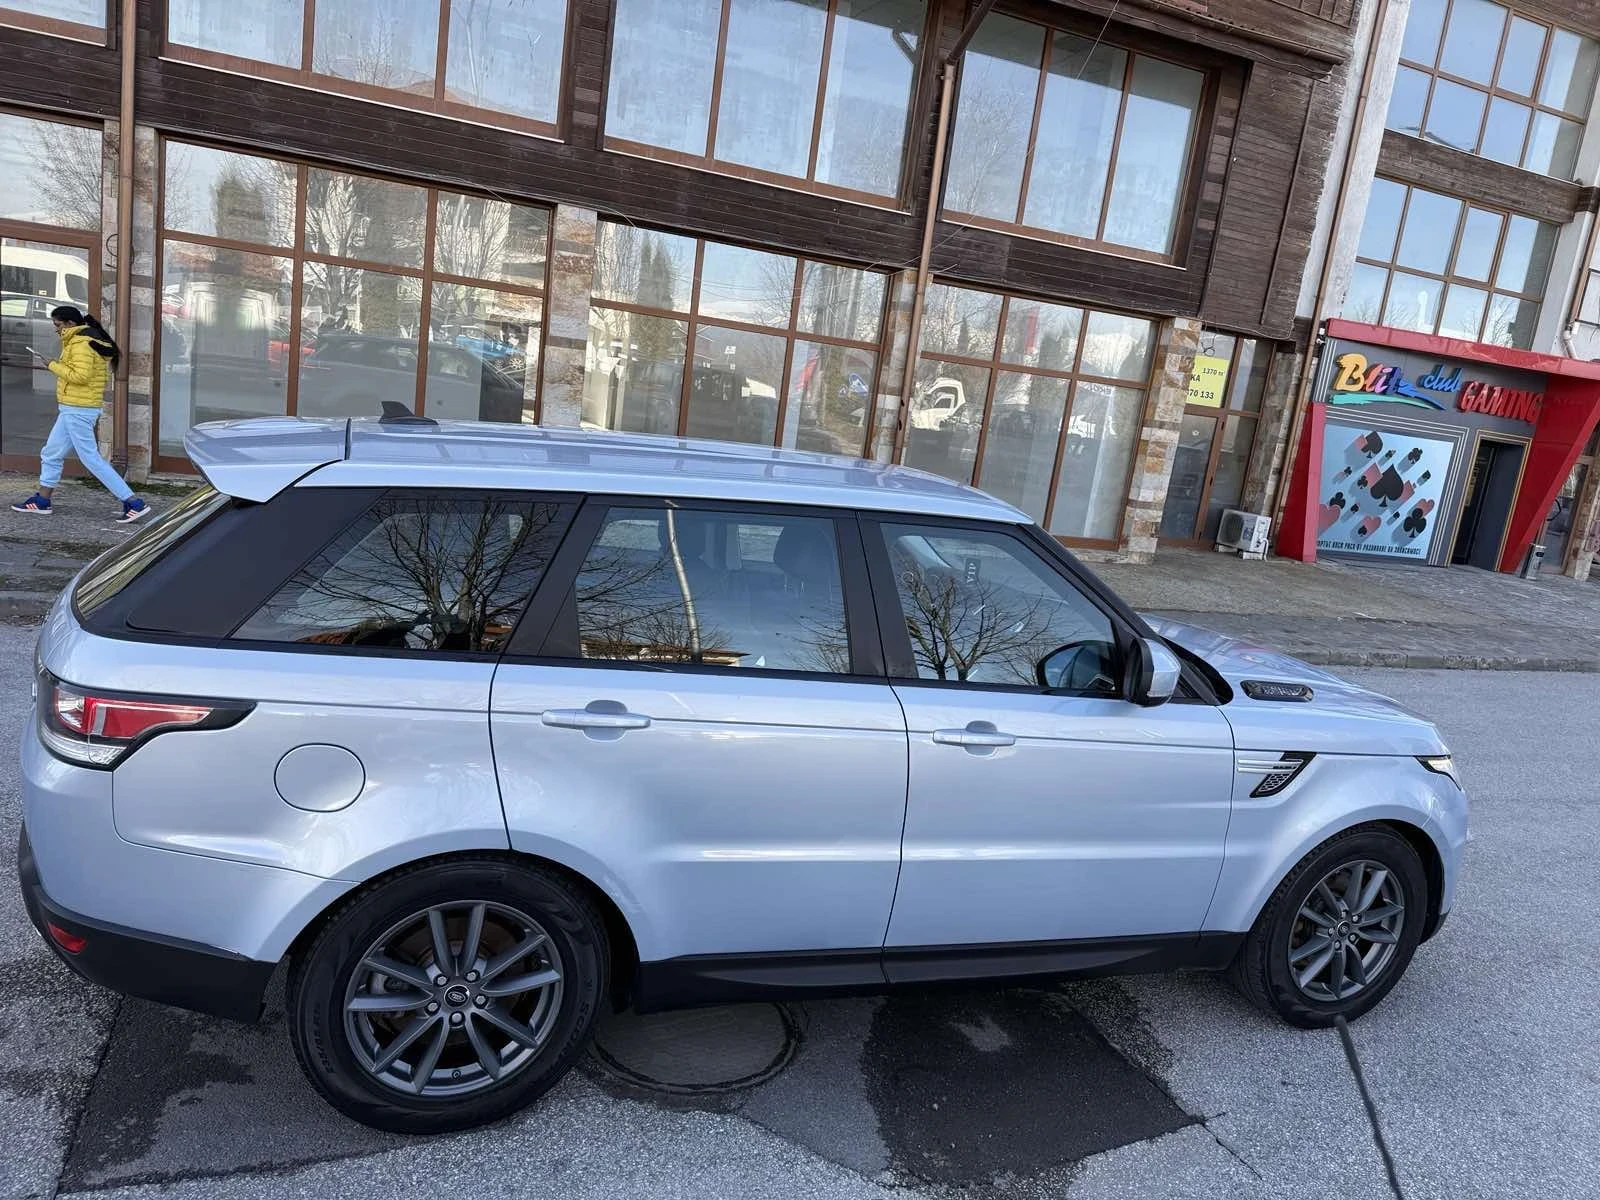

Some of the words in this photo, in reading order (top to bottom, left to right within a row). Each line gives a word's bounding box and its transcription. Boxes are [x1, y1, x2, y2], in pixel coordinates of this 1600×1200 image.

[1190, 374, 1201, 382] КА
[1188, 389, 1199, 398] 70
[1200, 391, 1214, 399] 133
[1419, 364, 1463, 393] club
[1458, 381, 1544, 424] GAMING
